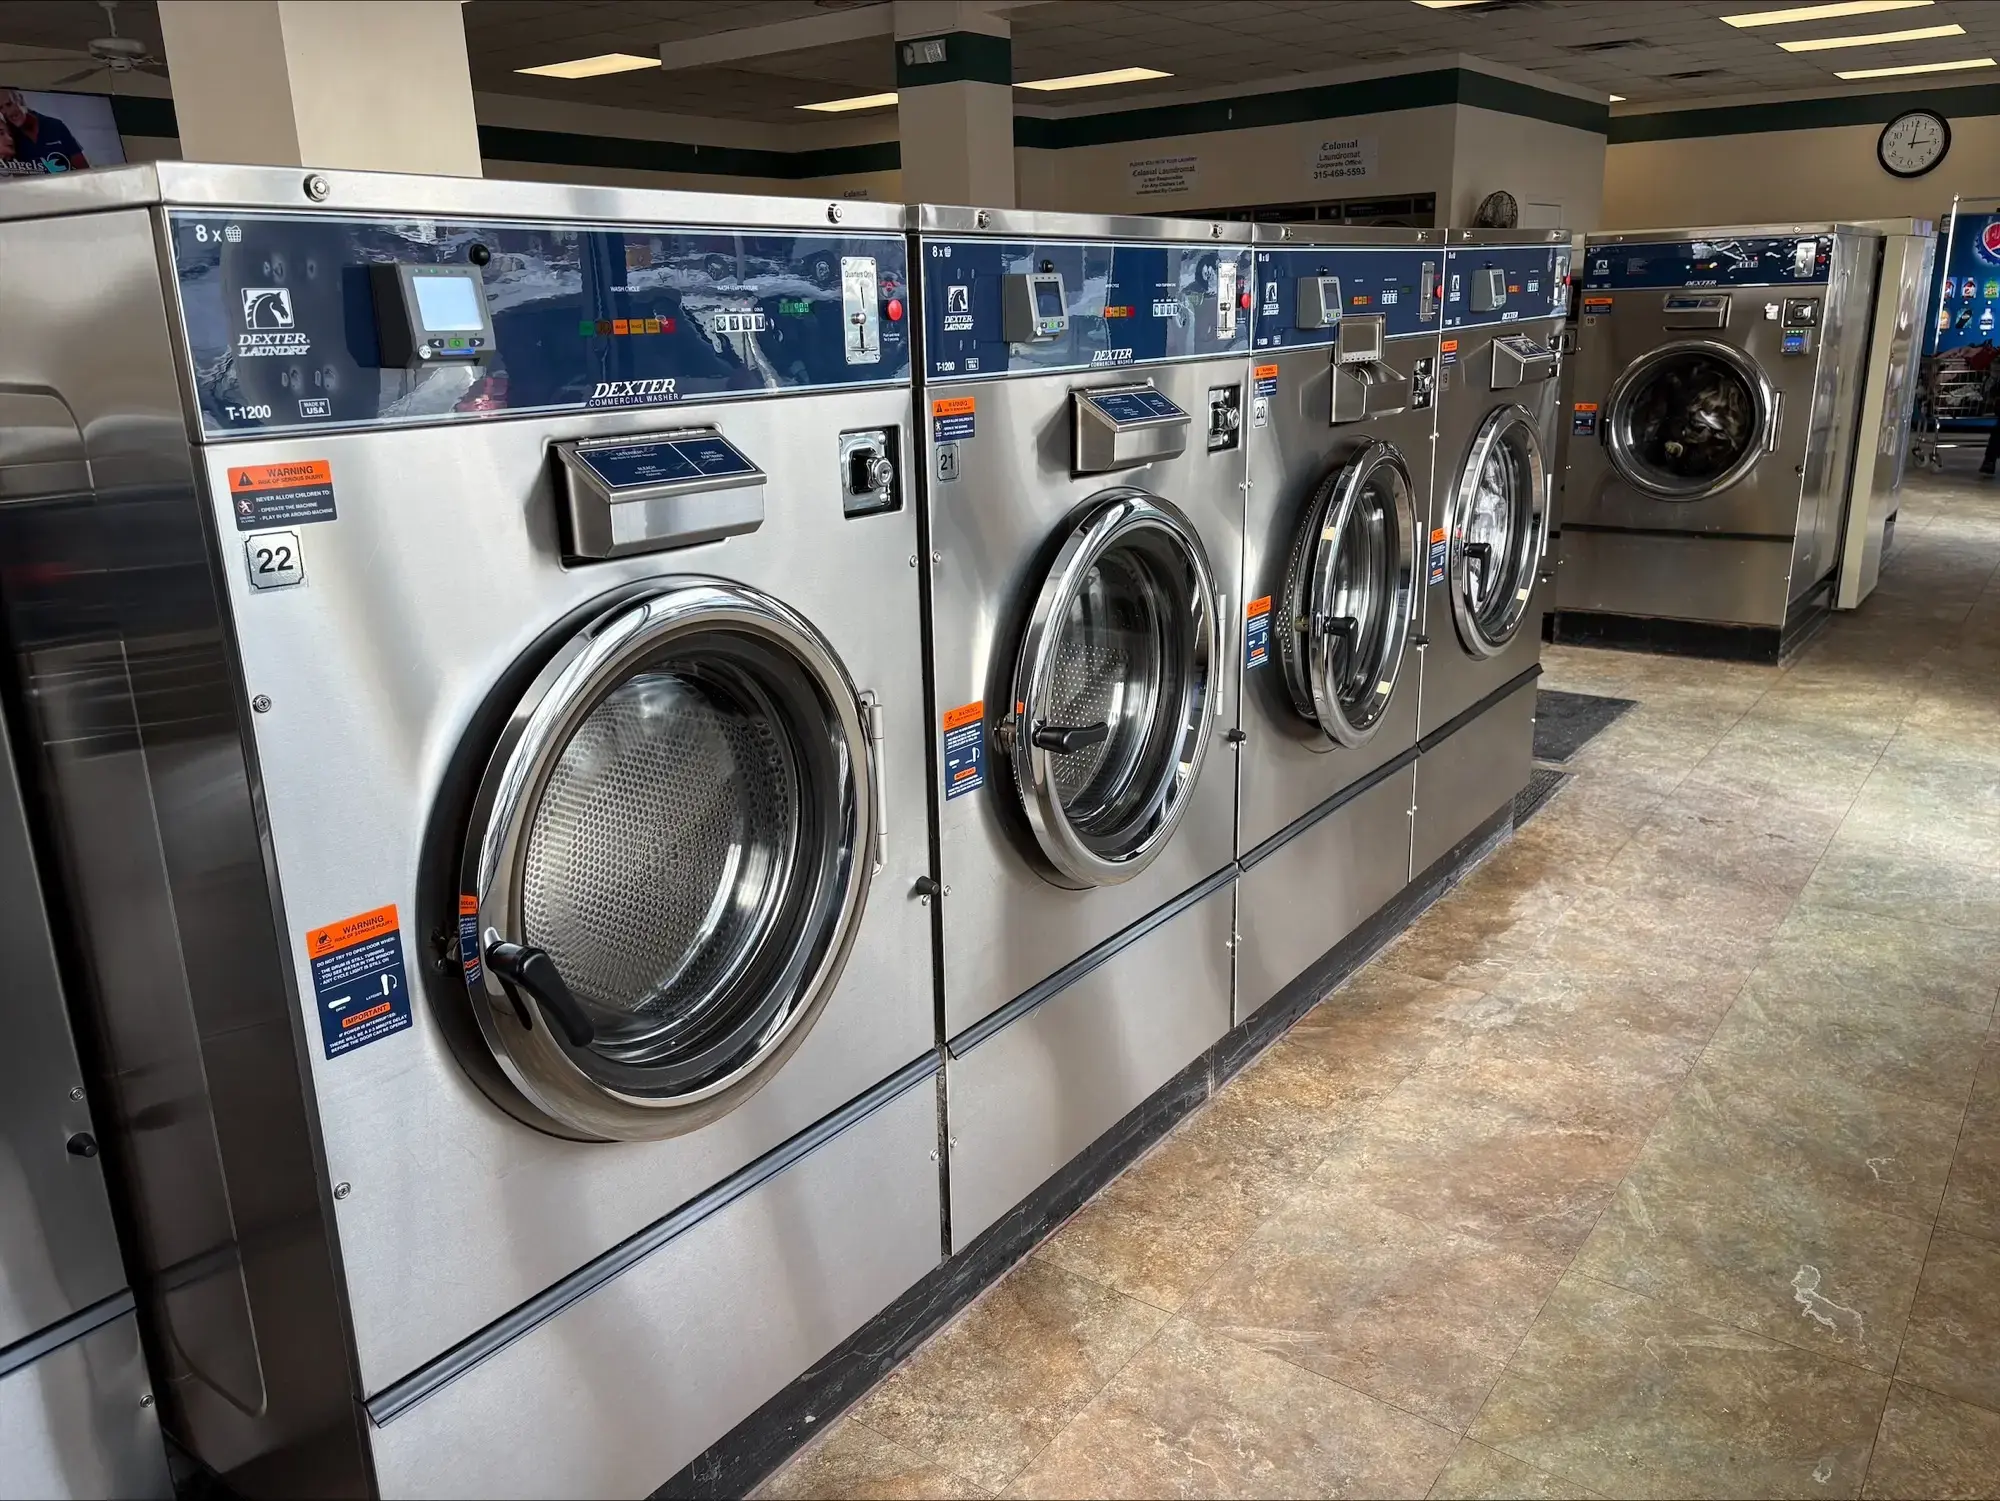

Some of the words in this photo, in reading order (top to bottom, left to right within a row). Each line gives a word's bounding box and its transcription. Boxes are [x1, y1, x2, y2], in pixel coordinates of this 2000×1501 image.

[1322, 140, 1357, 150] Colonial
[1319, 151, 1360, 161] Laundromat
[195, 224, 208, 242] 8
[932, 246, 938, 257] 8
[944, 315, 972, 323] DEXTER
[944, 323, 974, 331] LAUNDRY
[238, 332, 307, 346] DEXTER
[238, 345, 311, 357] LAUNDRY
[1092, 348, 1132, 361] DEXTER
[936, 362, 955, 372] T-1200
[591, 378, 675, 398] DEXTER
[589, 396, 643, 407] COMMERCIAL
[646, 393, 679, 402] WASHER
[226, 404, 272, 421] T-1200
[1256, 406, 1265, 419] 20
[940, 453, 953, 470] 21
[267, 466, 313, 477] WARNING
[256, 494, 274, 502] NEVER
[257, 546, 293, 574] 22
[342, 915, 384, 934] WARNING
[353, 946, 366, 955] OPEN
[331, 962, 345, 970] DRUM
[364, 948, 385, 958] TURNING
[343, 963, 360, 974] WATER
[376, 950, 395, 960] WINDOW
[333, 972, 349, 981] CYCLE
[349, 967, 363, 975] LIGHT
[346, 1005, 386, 1025] IMPORTANT
[330, 1040, 345, 1048] THERE
[376, 1020, 392, 1030] MINUTE
[392, 1014, 407, 1023] DELAY
[331, 1043, 349, 1053] BEFORE
[359, 1034, 372, 1042] DOOR
[389, 1019, 407, 1029] OPENED
[344, 1026, 360, 1036] POWER
